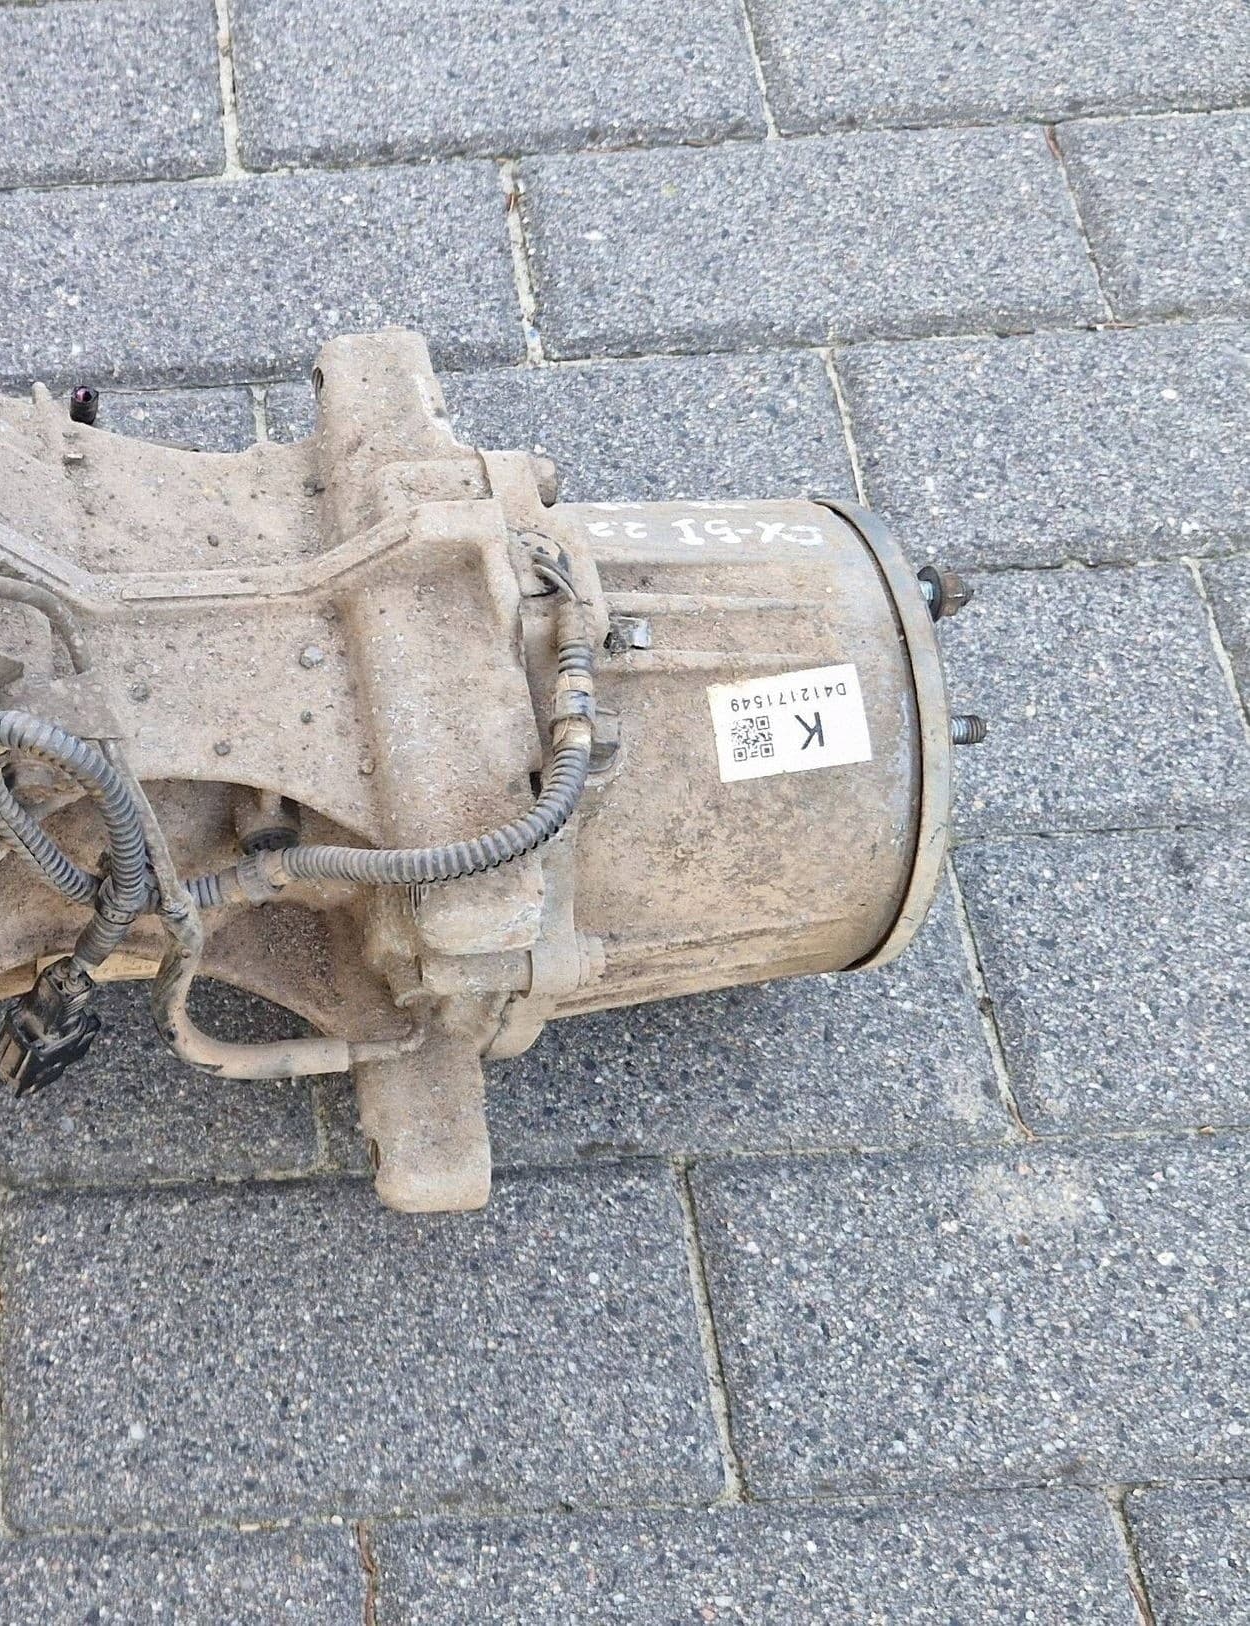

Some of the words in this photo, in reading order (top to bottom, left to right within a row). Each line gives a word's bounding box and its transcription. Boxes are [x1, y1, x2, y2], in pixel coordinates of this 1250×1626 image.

[585, 521, 648, 539] 2.2
[730, 682, 847, 712] D412171549
[794, 711, 825, 751] K
